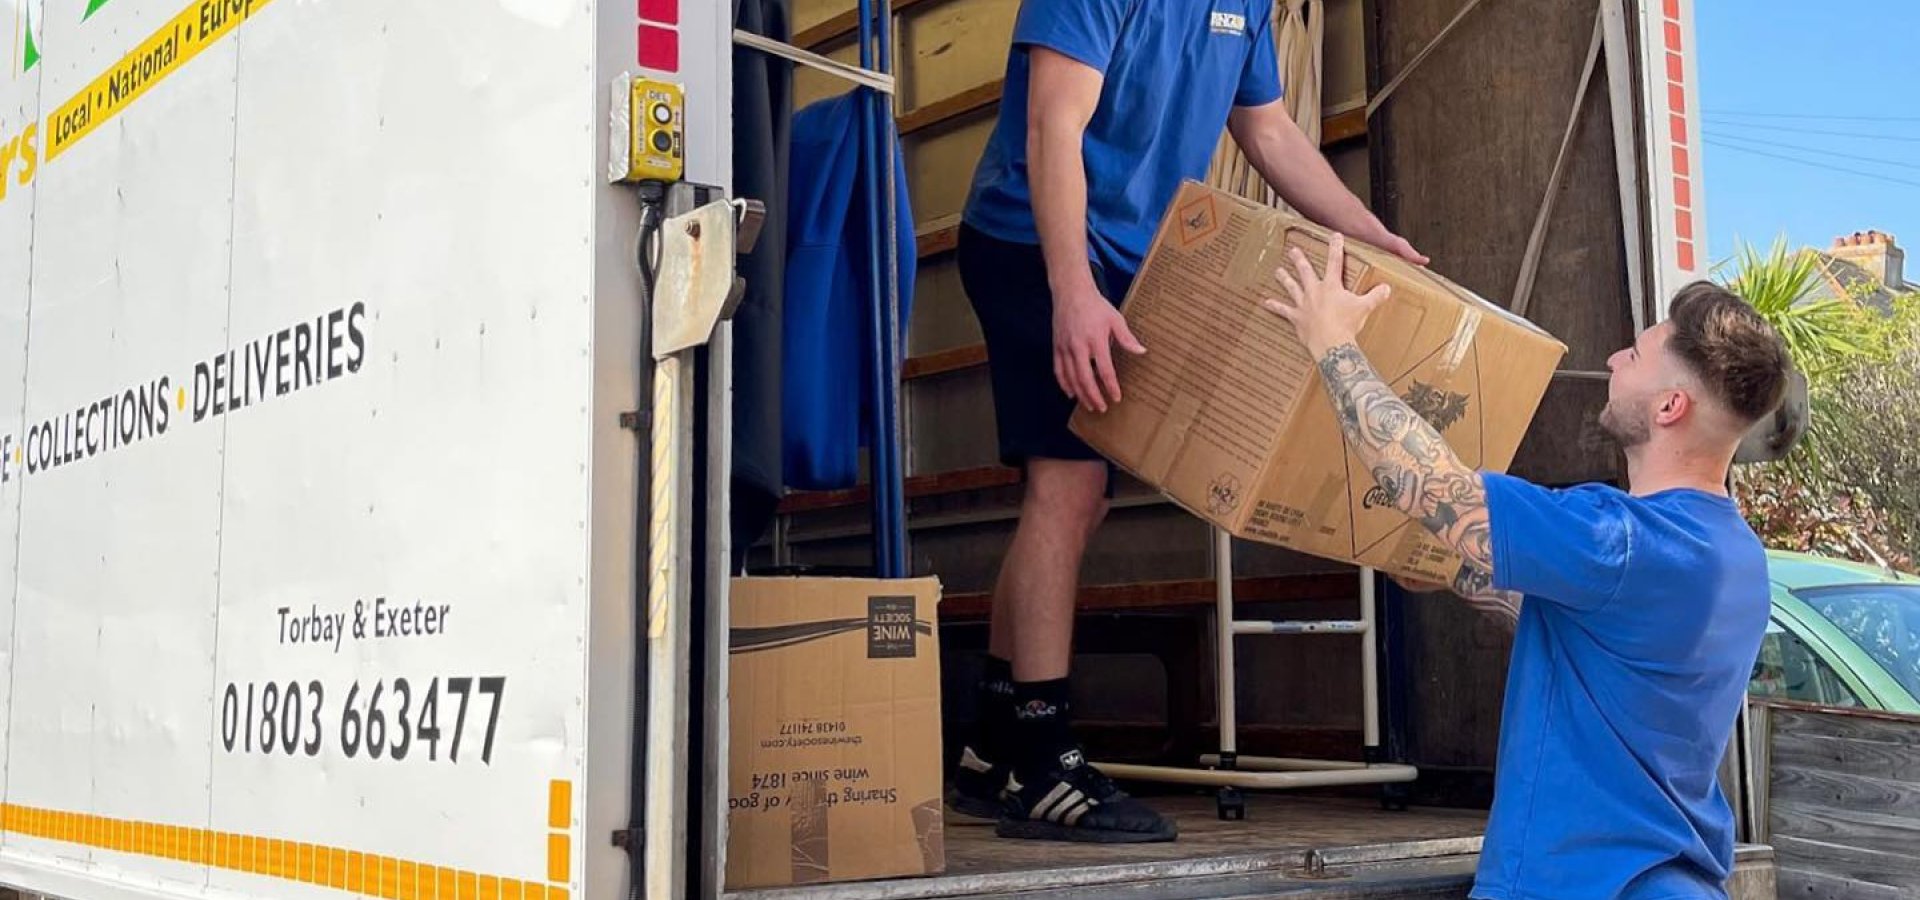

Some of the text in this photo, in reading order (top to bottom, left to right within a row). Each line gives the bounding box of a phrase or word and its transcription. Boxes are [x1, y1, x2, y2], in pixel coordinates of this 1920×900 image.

[55, 92, 92, 146] Local
[107, 26, 178, 109] National
[27, 376, 170, 475] COLLECTIONS
[193, 301, 365, 423] DELIVERIES
[277, 598, 450, 653] Torbay & Exeter
[872, 613, 912, 623] SOCIETY
[872, 625, 912, 641] WINE
[222, 676, 507, 767] 01803 663477
[752, 768, 869, 789] wine since 1874
[761, 796, 780, 812] of
[844, 787, 897, 805] Sharing
